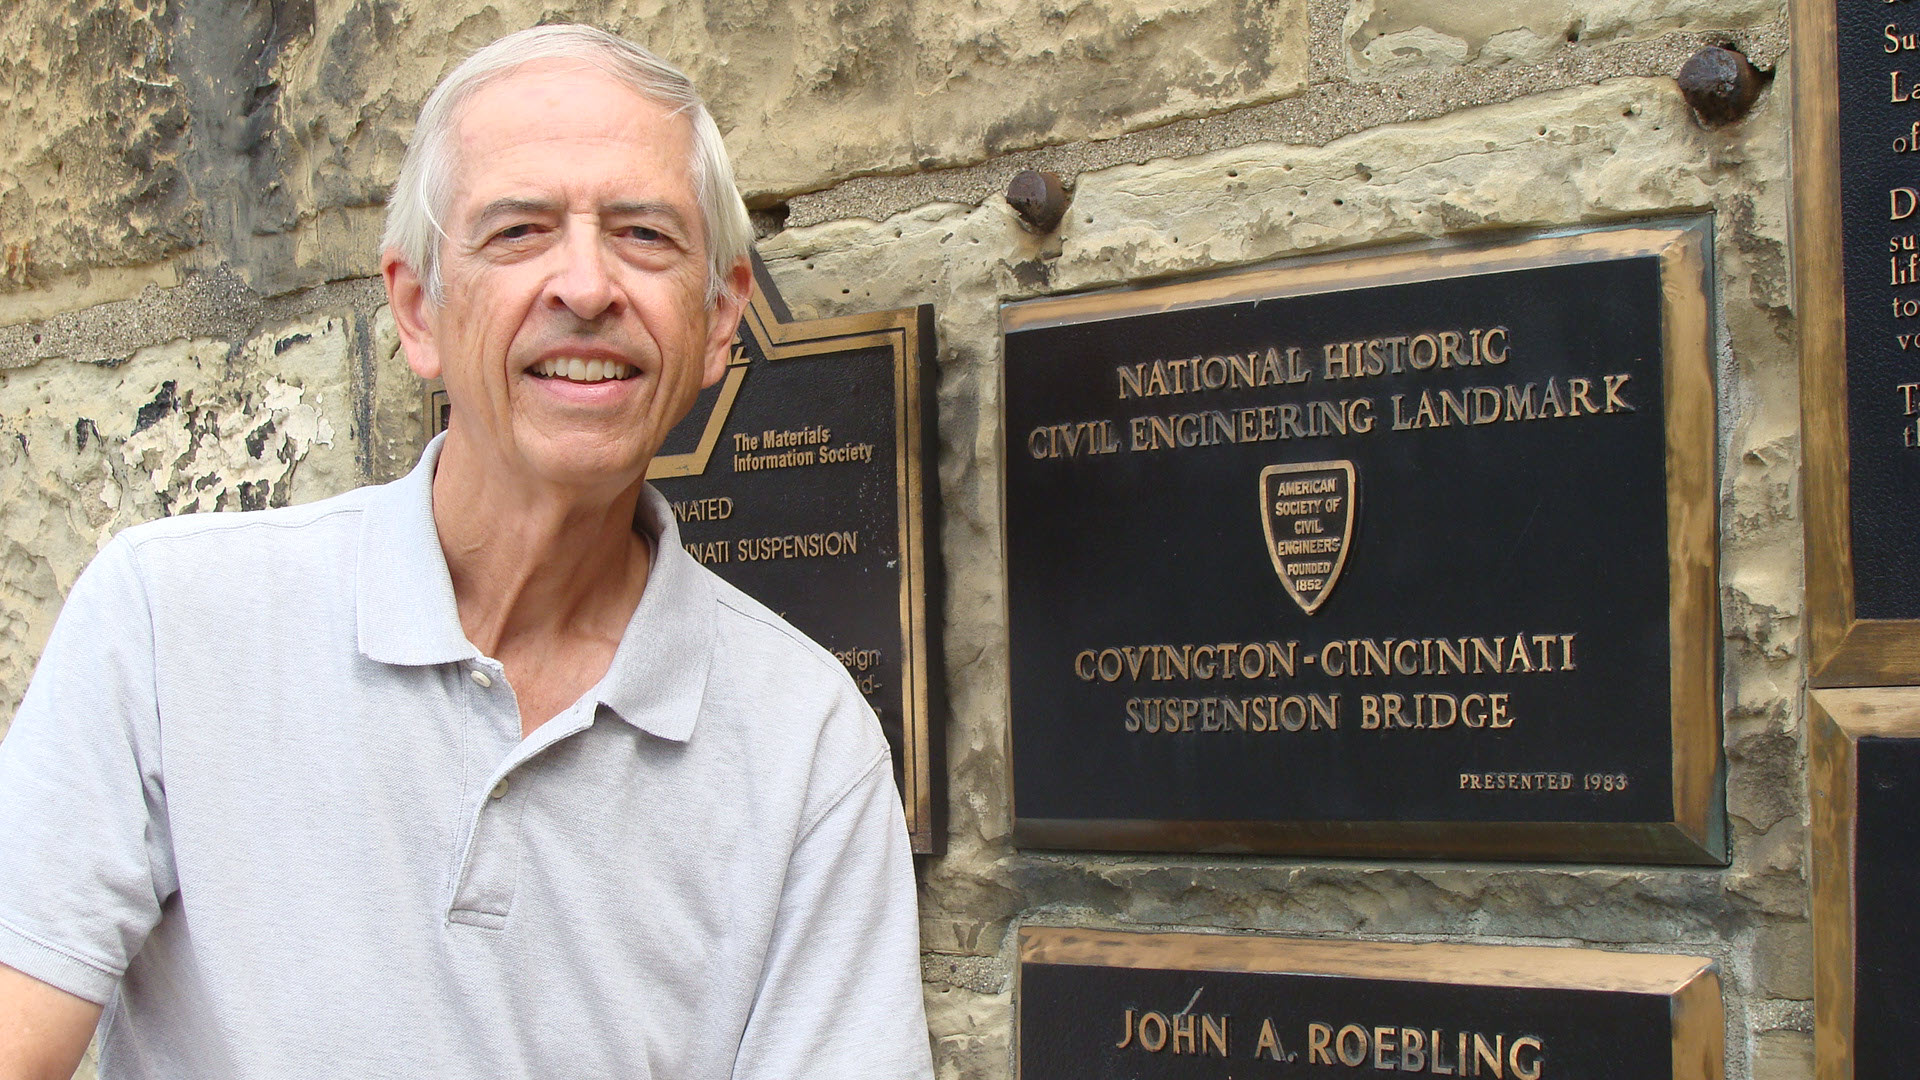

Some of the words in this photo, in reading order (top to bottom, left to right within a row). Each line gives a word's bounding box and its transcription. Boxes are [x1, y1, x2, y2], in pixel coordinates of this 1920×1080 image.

[1117, 348, 1311, 399] NATIONAL
[1323, 326, 1511, 380] HISTORIC
[1028, 420, 1121, 460] CIVIL
[1130, 398, 1376, 451] ENGINEERING
[1391, 374, 1635, 431] LANDMARK
[733, 432, 759, 452] The
[763, 425, 831, 449] Materials
[734, 448, 814, 472] Information
[819, 443, 874, 464] Society
[1278, 479, 1337, 497] AMERICAN
[1275, 500, 1322, 517] SOCIETY
[1325, 497, 1342, 513] OF
[1294, 519, 1324, 535] CIVIL
[685, 541, 730, 563] NATI
[737, 531, 858, 562] SUSPENSION
[1278, 538, 1341, 556] ENGINEERS
[1287, 562, 1332, 576] FOUNDED
[1295, 579, 1323, 592] 1852
[830, 647, 881, 671] esign
[1125, 693, 1342, 734] SUSPENSION
[1360, 692, 1516, 730] BRIDGE
[1459, 772, 1572, 791] PRESENTED
[1584, 773, 1627, 792] 1983
[1116, 1009, 1229, 1058] JOHN
[1254, 1017, 1297, 1063] A.
[1308, 1021, 1543, 1080] ROEBLING
